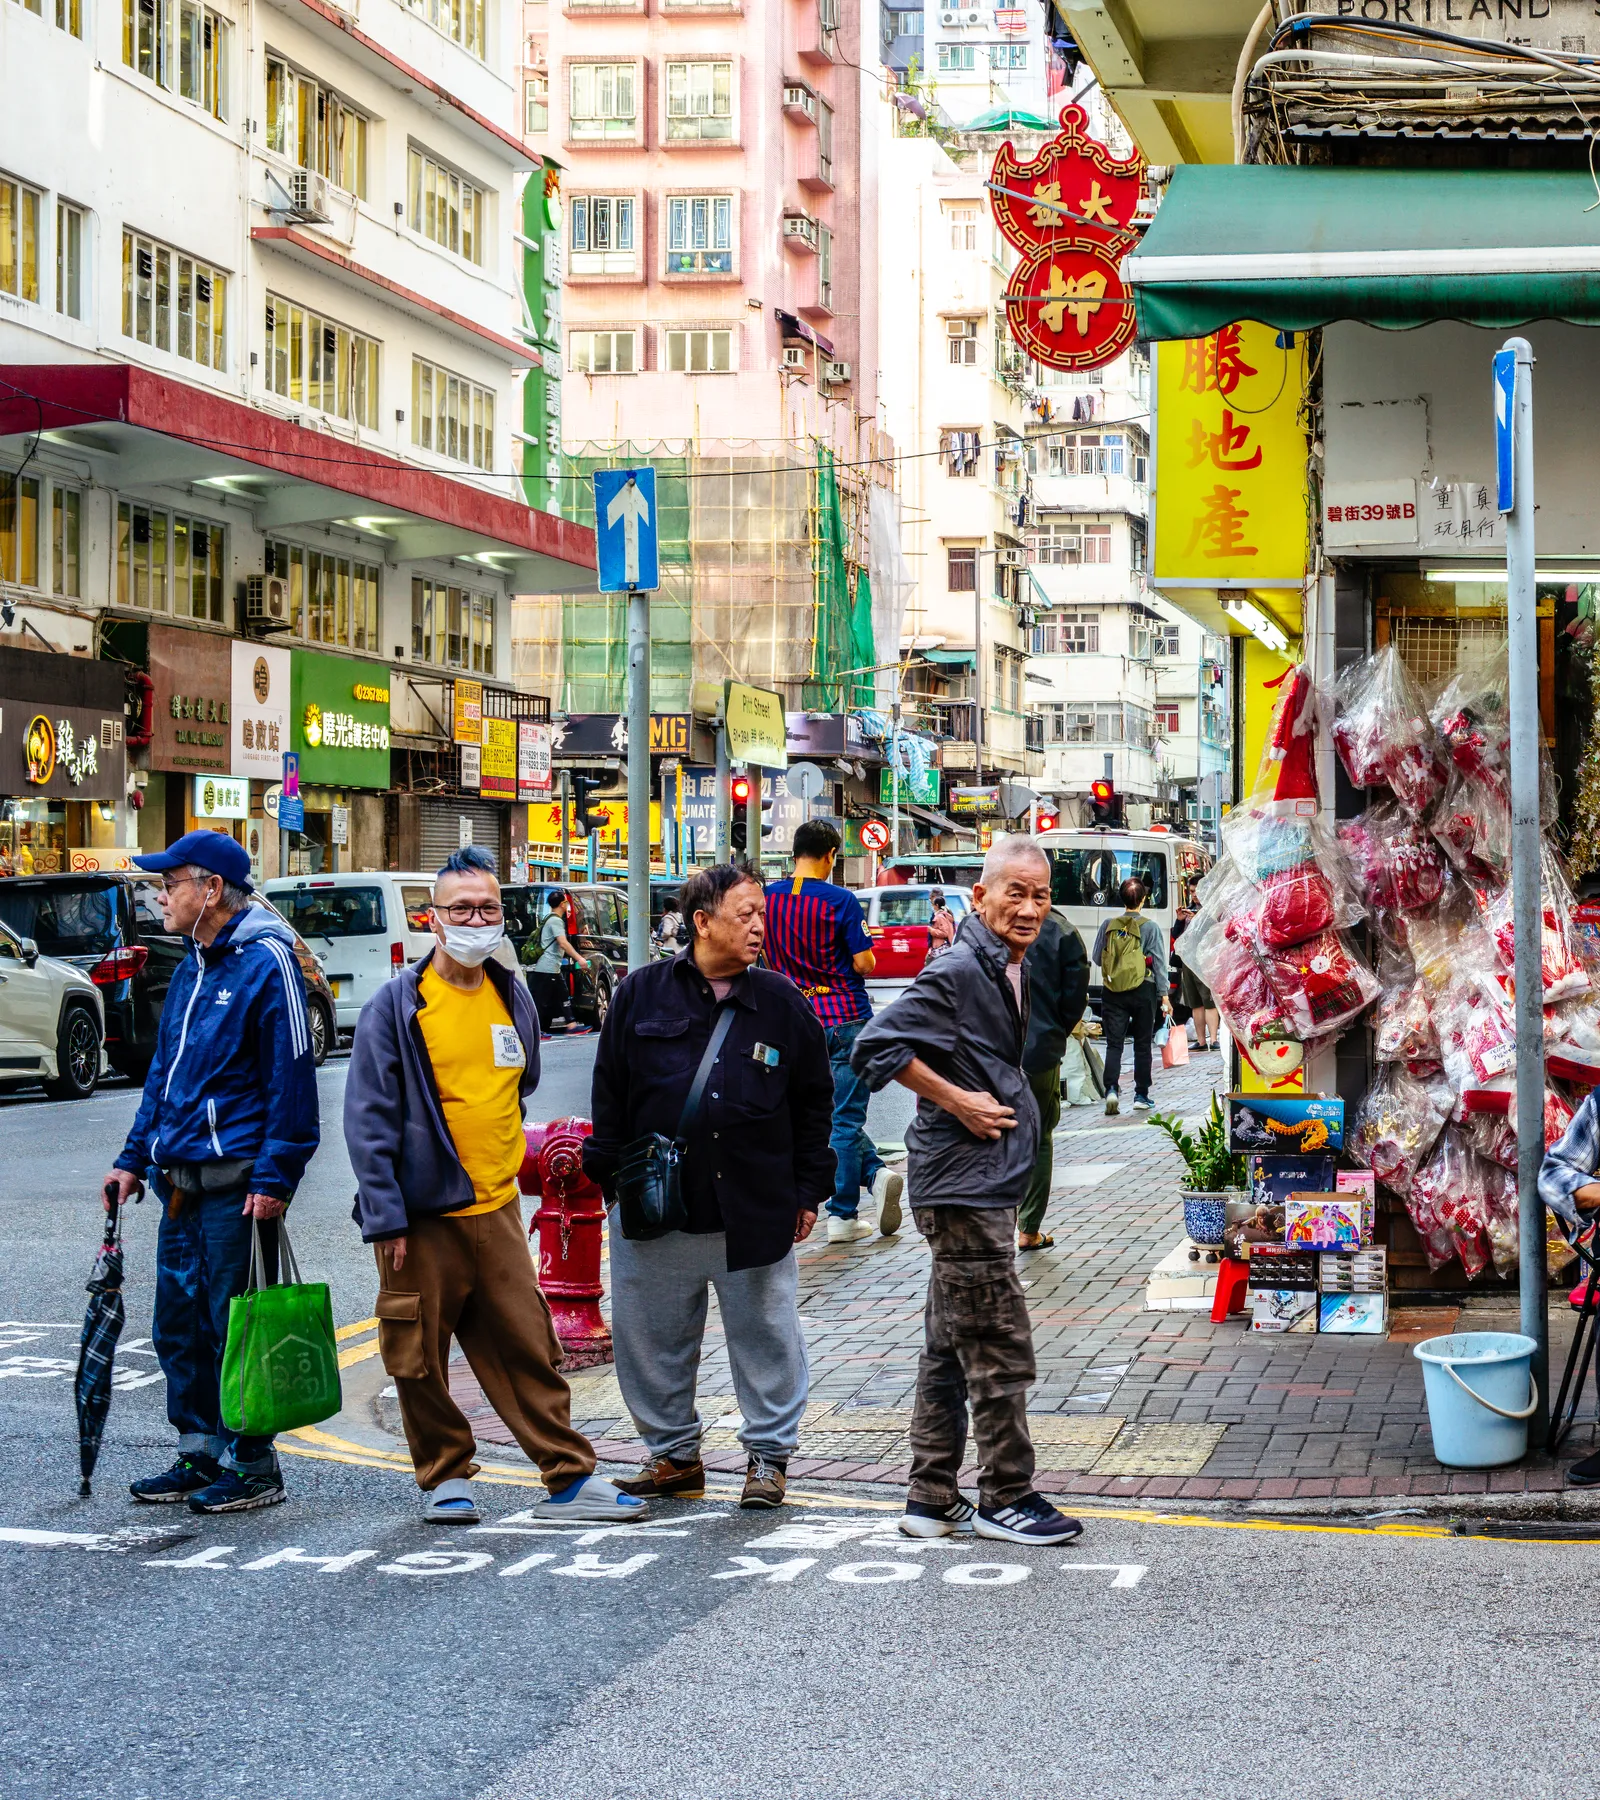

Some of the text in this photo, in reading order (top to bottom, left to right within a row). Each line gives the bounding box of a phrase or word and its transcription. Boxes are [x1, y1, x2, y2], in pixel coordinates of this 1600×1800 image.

[1039, 264, 1109, 337] 押
[1178, 323, 1263, 560] 勝地產
[1327, 503, 1416, 522] 碧街39號B
[1434, 517, 1495, 539] 玩具行
[743, 694, 770, 719] Pitt Street
[243, 752, 260, 760] LUGGAGE
[286, 756, 297, 794] P
[779, 804, 800, 818] LTD.
[141, 1546, 1149, 1588] LOOK RIGHT
